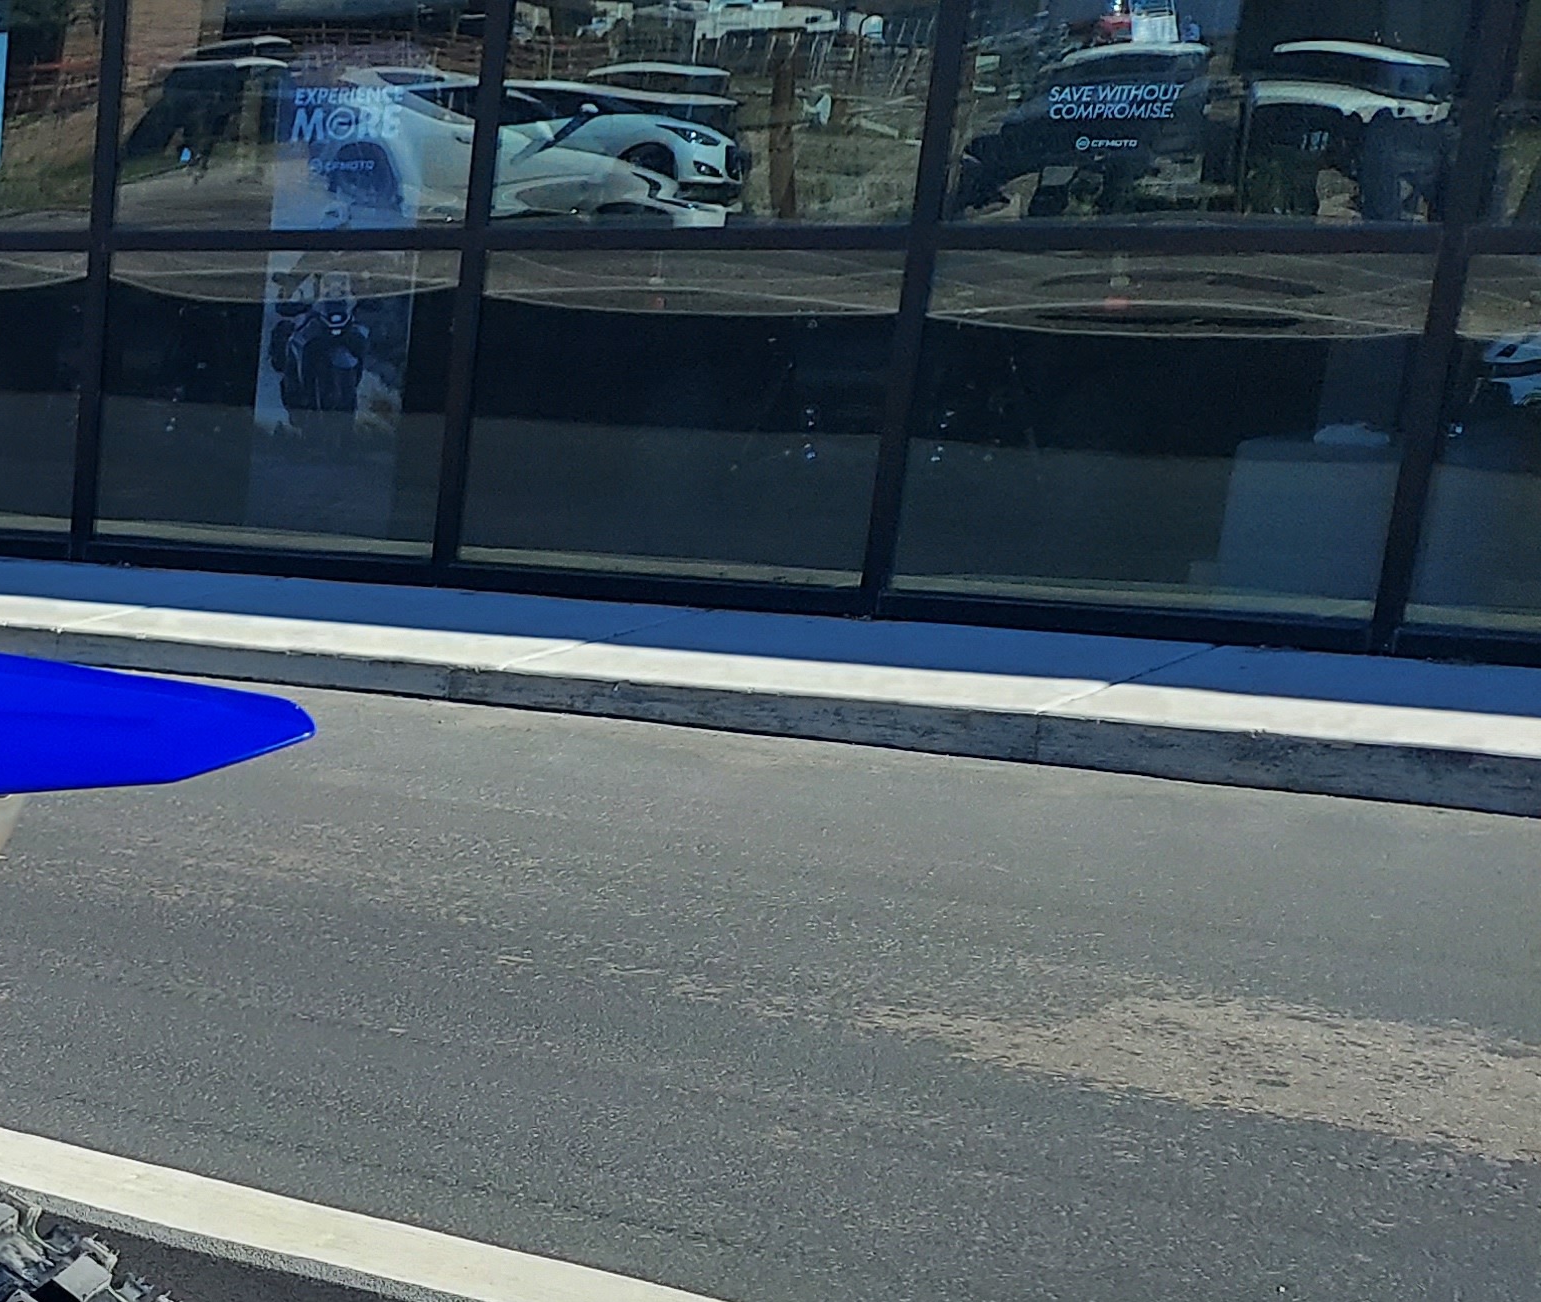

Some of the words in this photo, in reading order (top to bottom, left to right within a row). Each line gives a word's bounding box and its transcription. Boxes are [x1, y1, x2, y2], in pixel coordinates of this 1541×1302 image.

[294, 86, 404, 105] EXPERIENCE
[1049, 85, 1095, 102] SAVE
[1097, 84, 1184, 102] WITHOUT
[1049, 102, 1174, 119] COMPROMISE.
[1090, 139, 1138, 148] CFMOTO
